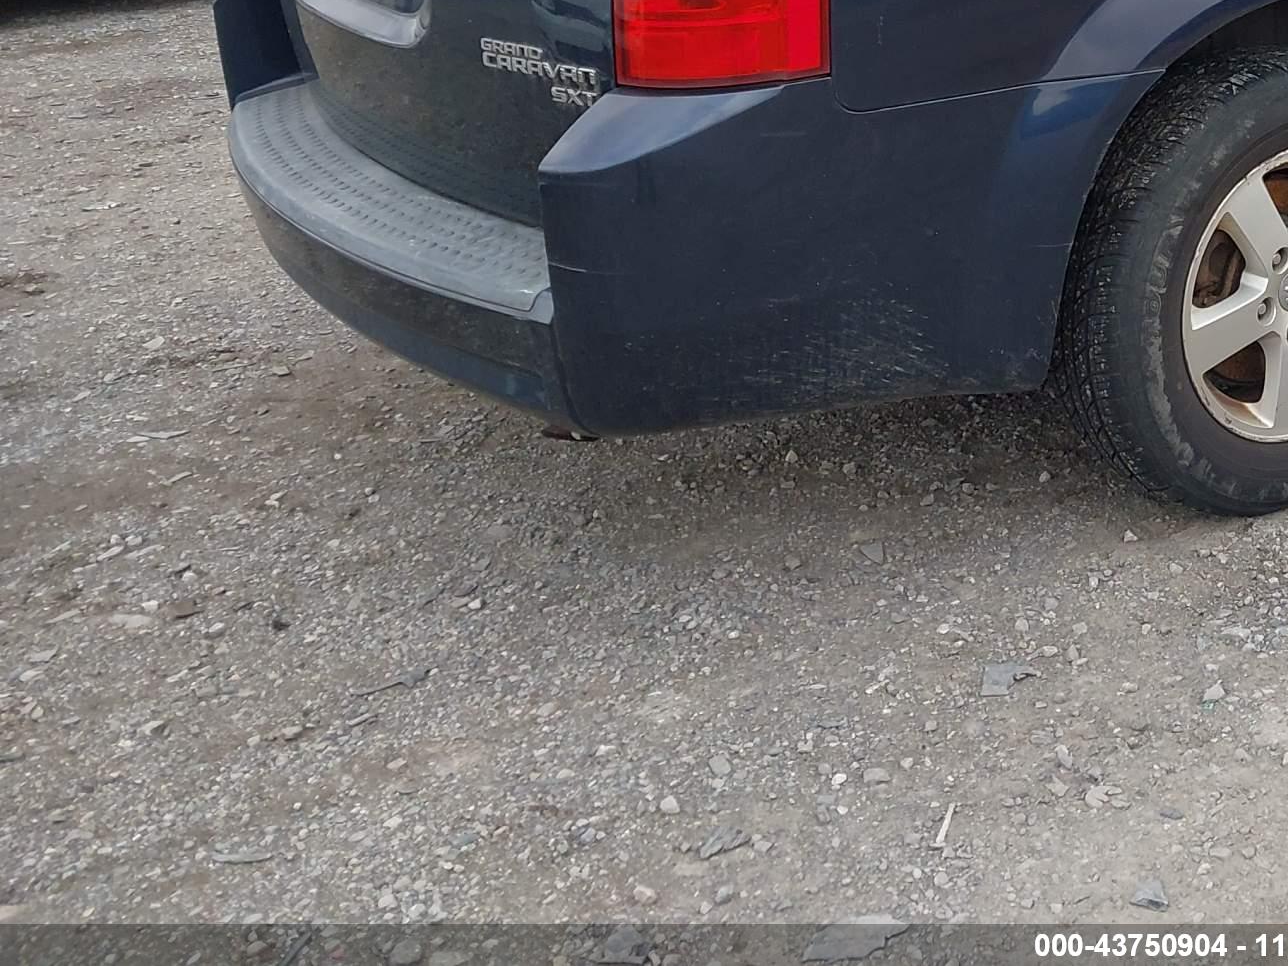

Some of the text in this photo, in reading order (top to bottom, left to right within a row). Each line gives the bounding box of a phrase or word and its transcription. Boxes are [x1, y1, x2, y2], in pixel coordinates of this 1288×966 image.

[481, 37, 543, 60] GRAND
[482, 51, 597, 85] CARAVAN
[551, 86, 598, 106] SXT
